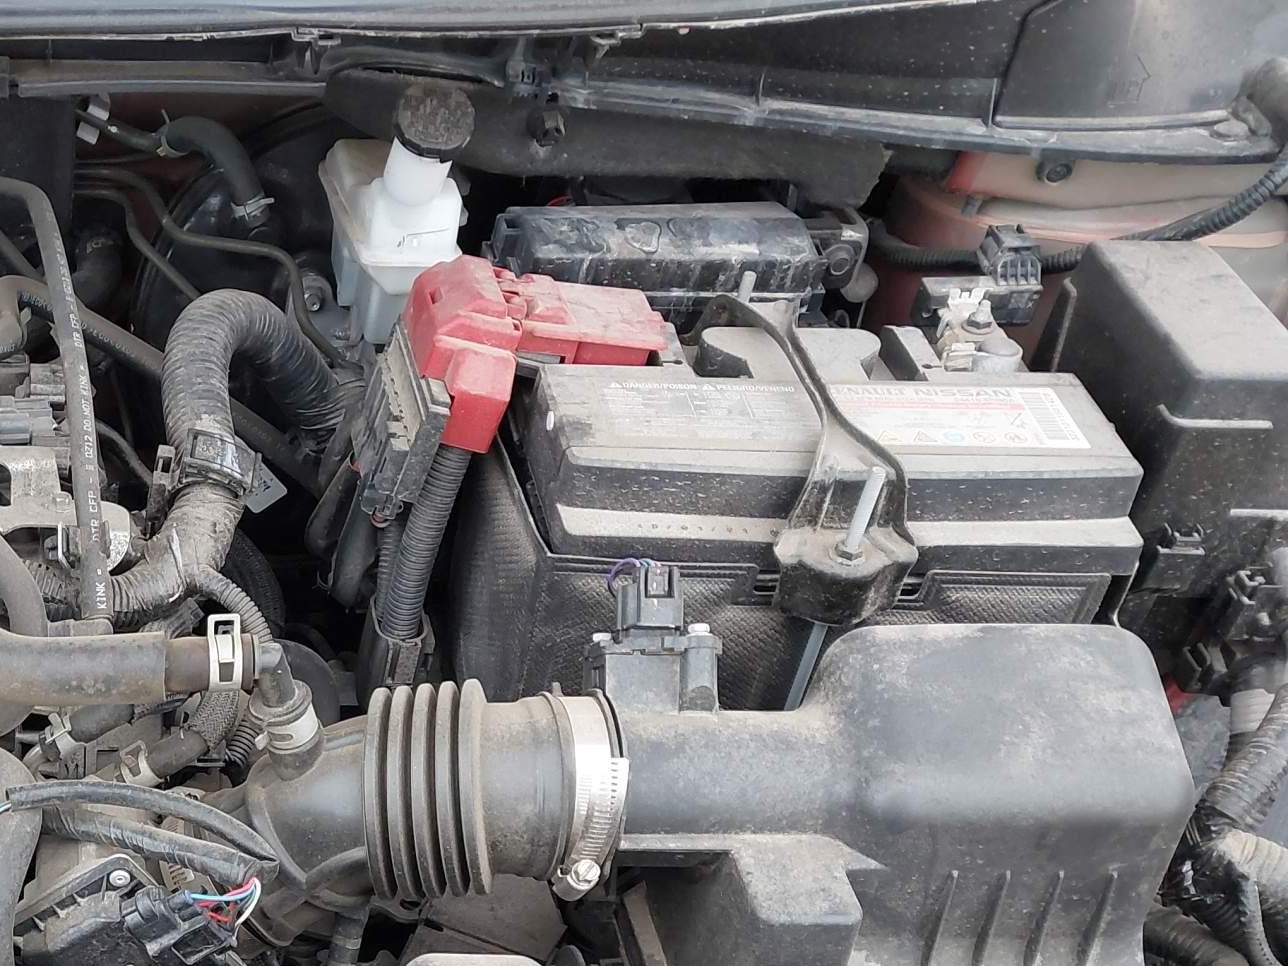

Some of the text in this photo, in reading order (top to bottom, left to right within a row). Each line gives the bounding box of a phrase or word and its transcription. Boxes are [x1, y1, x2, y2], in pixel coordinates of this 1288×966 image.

[78, 374, 89, 395] KINK
[914, 388, 1013, 398] NISSAN
[81, 398, 91, 416] NOT
[87, 490, 98, 513] CFP
[95, 582, 108, 609] KINK
